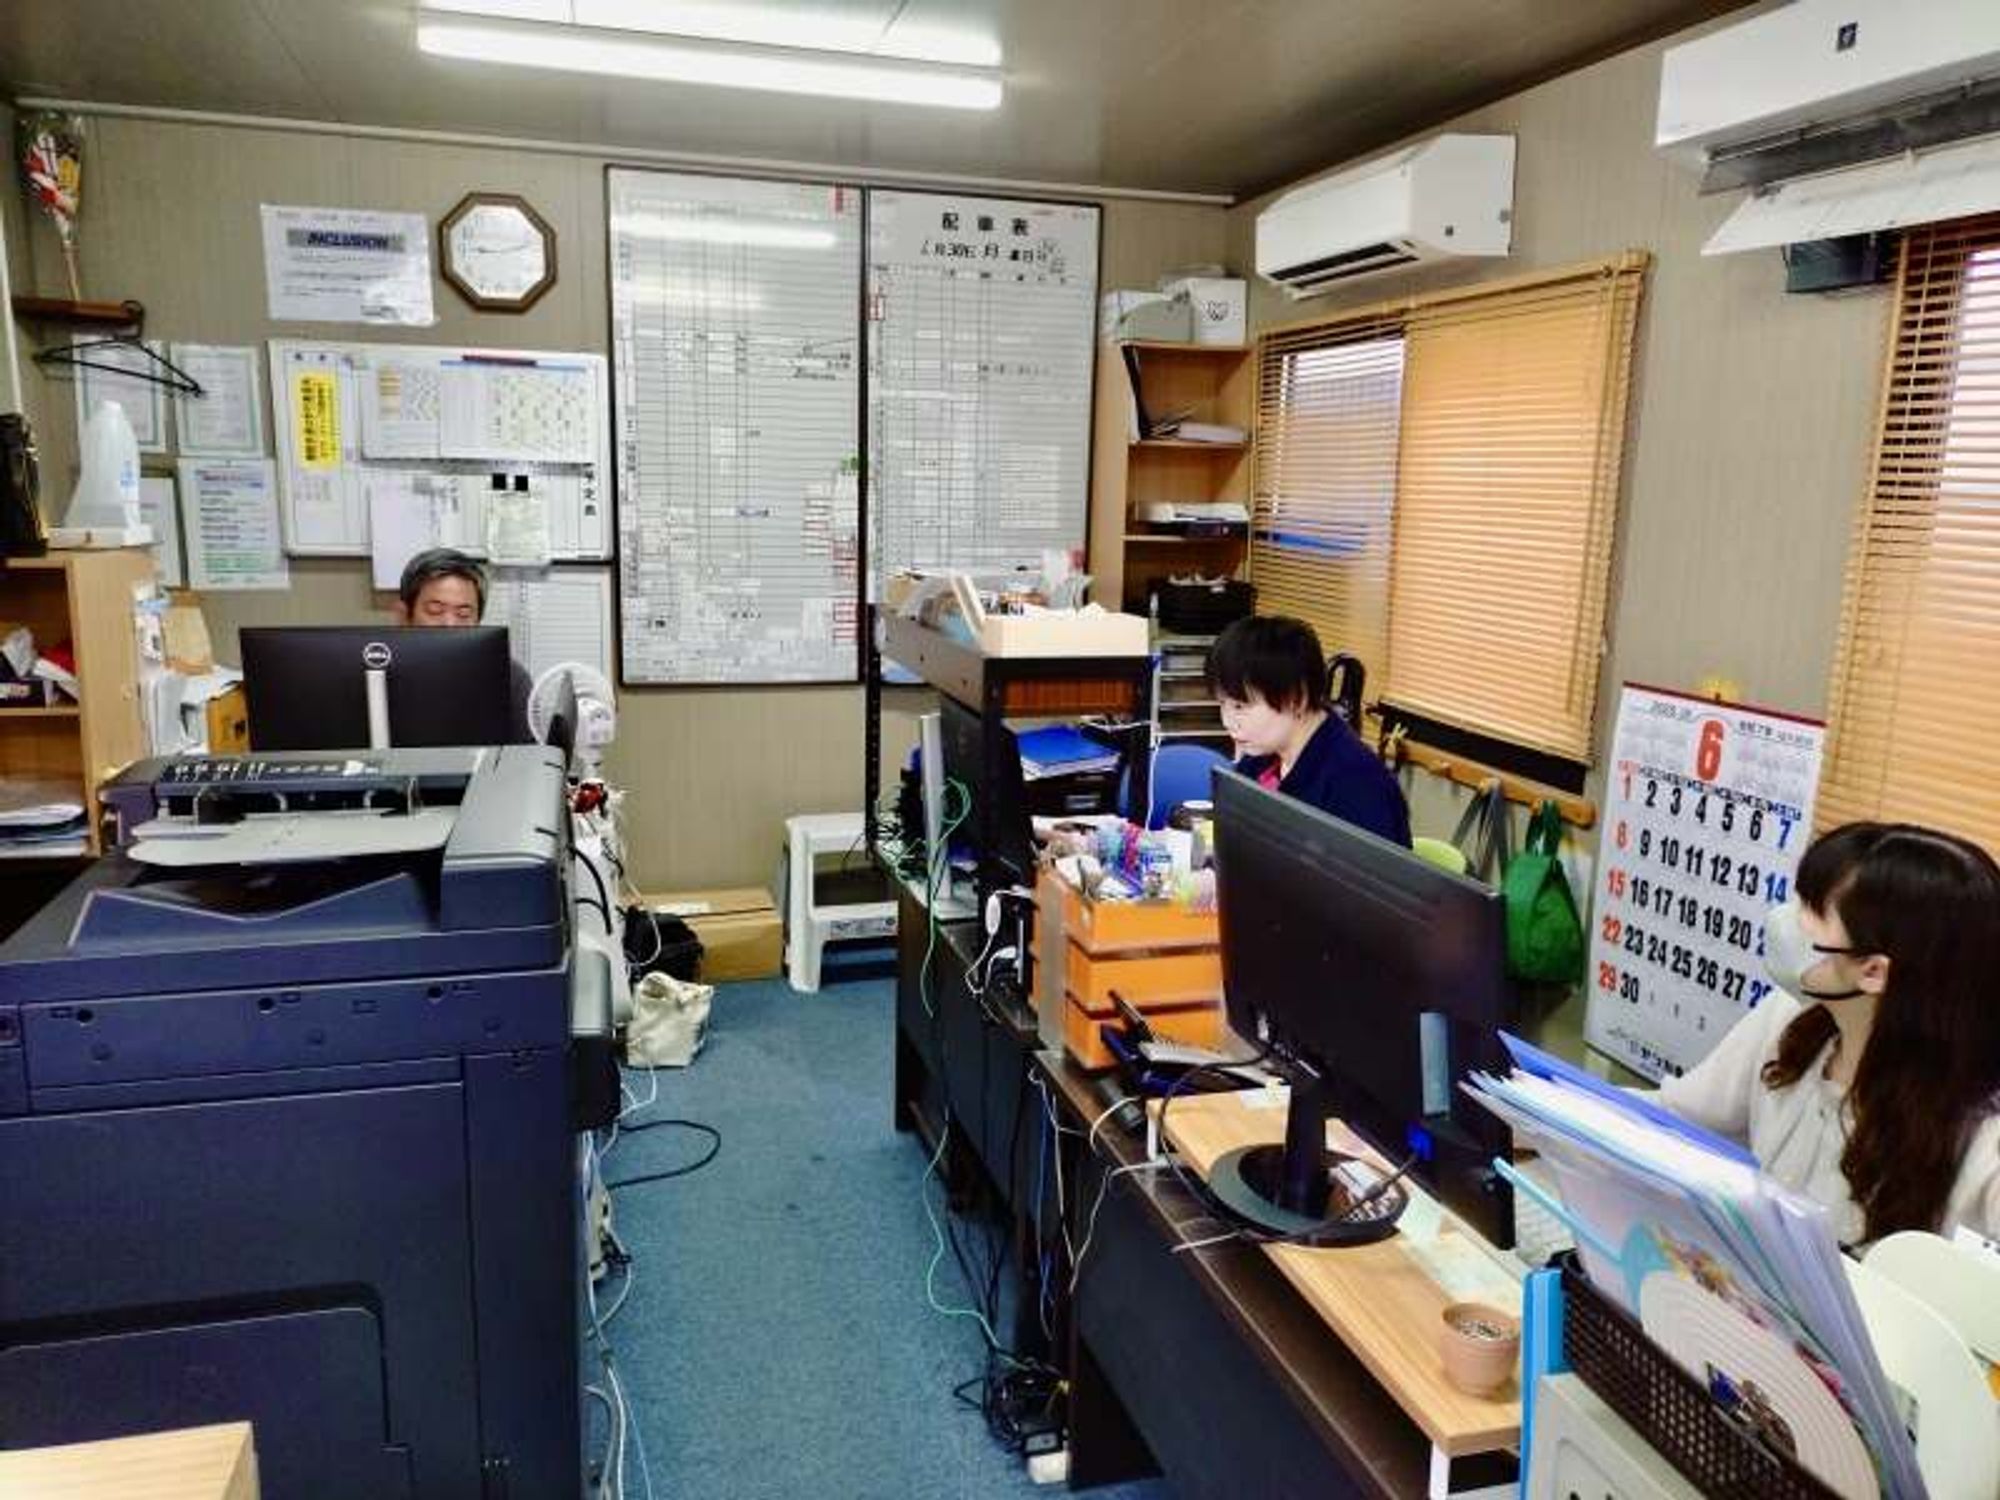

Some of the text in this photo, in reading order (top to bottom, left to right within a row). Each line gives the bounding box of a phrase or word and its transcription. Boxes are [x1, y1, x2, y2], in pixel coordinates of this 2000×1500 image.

[1697, 720, 1724, 781] 6
[1622, 773, 1631, 801] 1
[1645, 780, 1657, 807] 2
[1670, 787, 1681, 815] 3
[1695, 795, 1707, 823] 4
[1722, 803, 1735, 831] 5
[1750, 810, 1763, 841] 6
[1778, 820, 1791, 849] 7
[1617, 821, 1787, 903] 8 9 10 11 12 13 14
[1607, 868, 1625, 897] 15
[1631, 877, 1649, 908] 16
[1654, 886, 1673, 916] 17
[1678, 896, 1698, 928] 18
[1703, 906, 1723, 938] 19
[1728, 916, 1751, 950] 20
[1598, 960, 1616, 991] 29
[1620, 972, 1640, 1004] 30
[1602, 915, 1621, 944] 22
[1625, 925, 1644, 956] 23
[1648, 935, 1668, 967] 24
[1672, 945, 1693, 978] 25
[1697, 956, 1719, 990] 26
[1722, 967, 1746, 1001] 27
